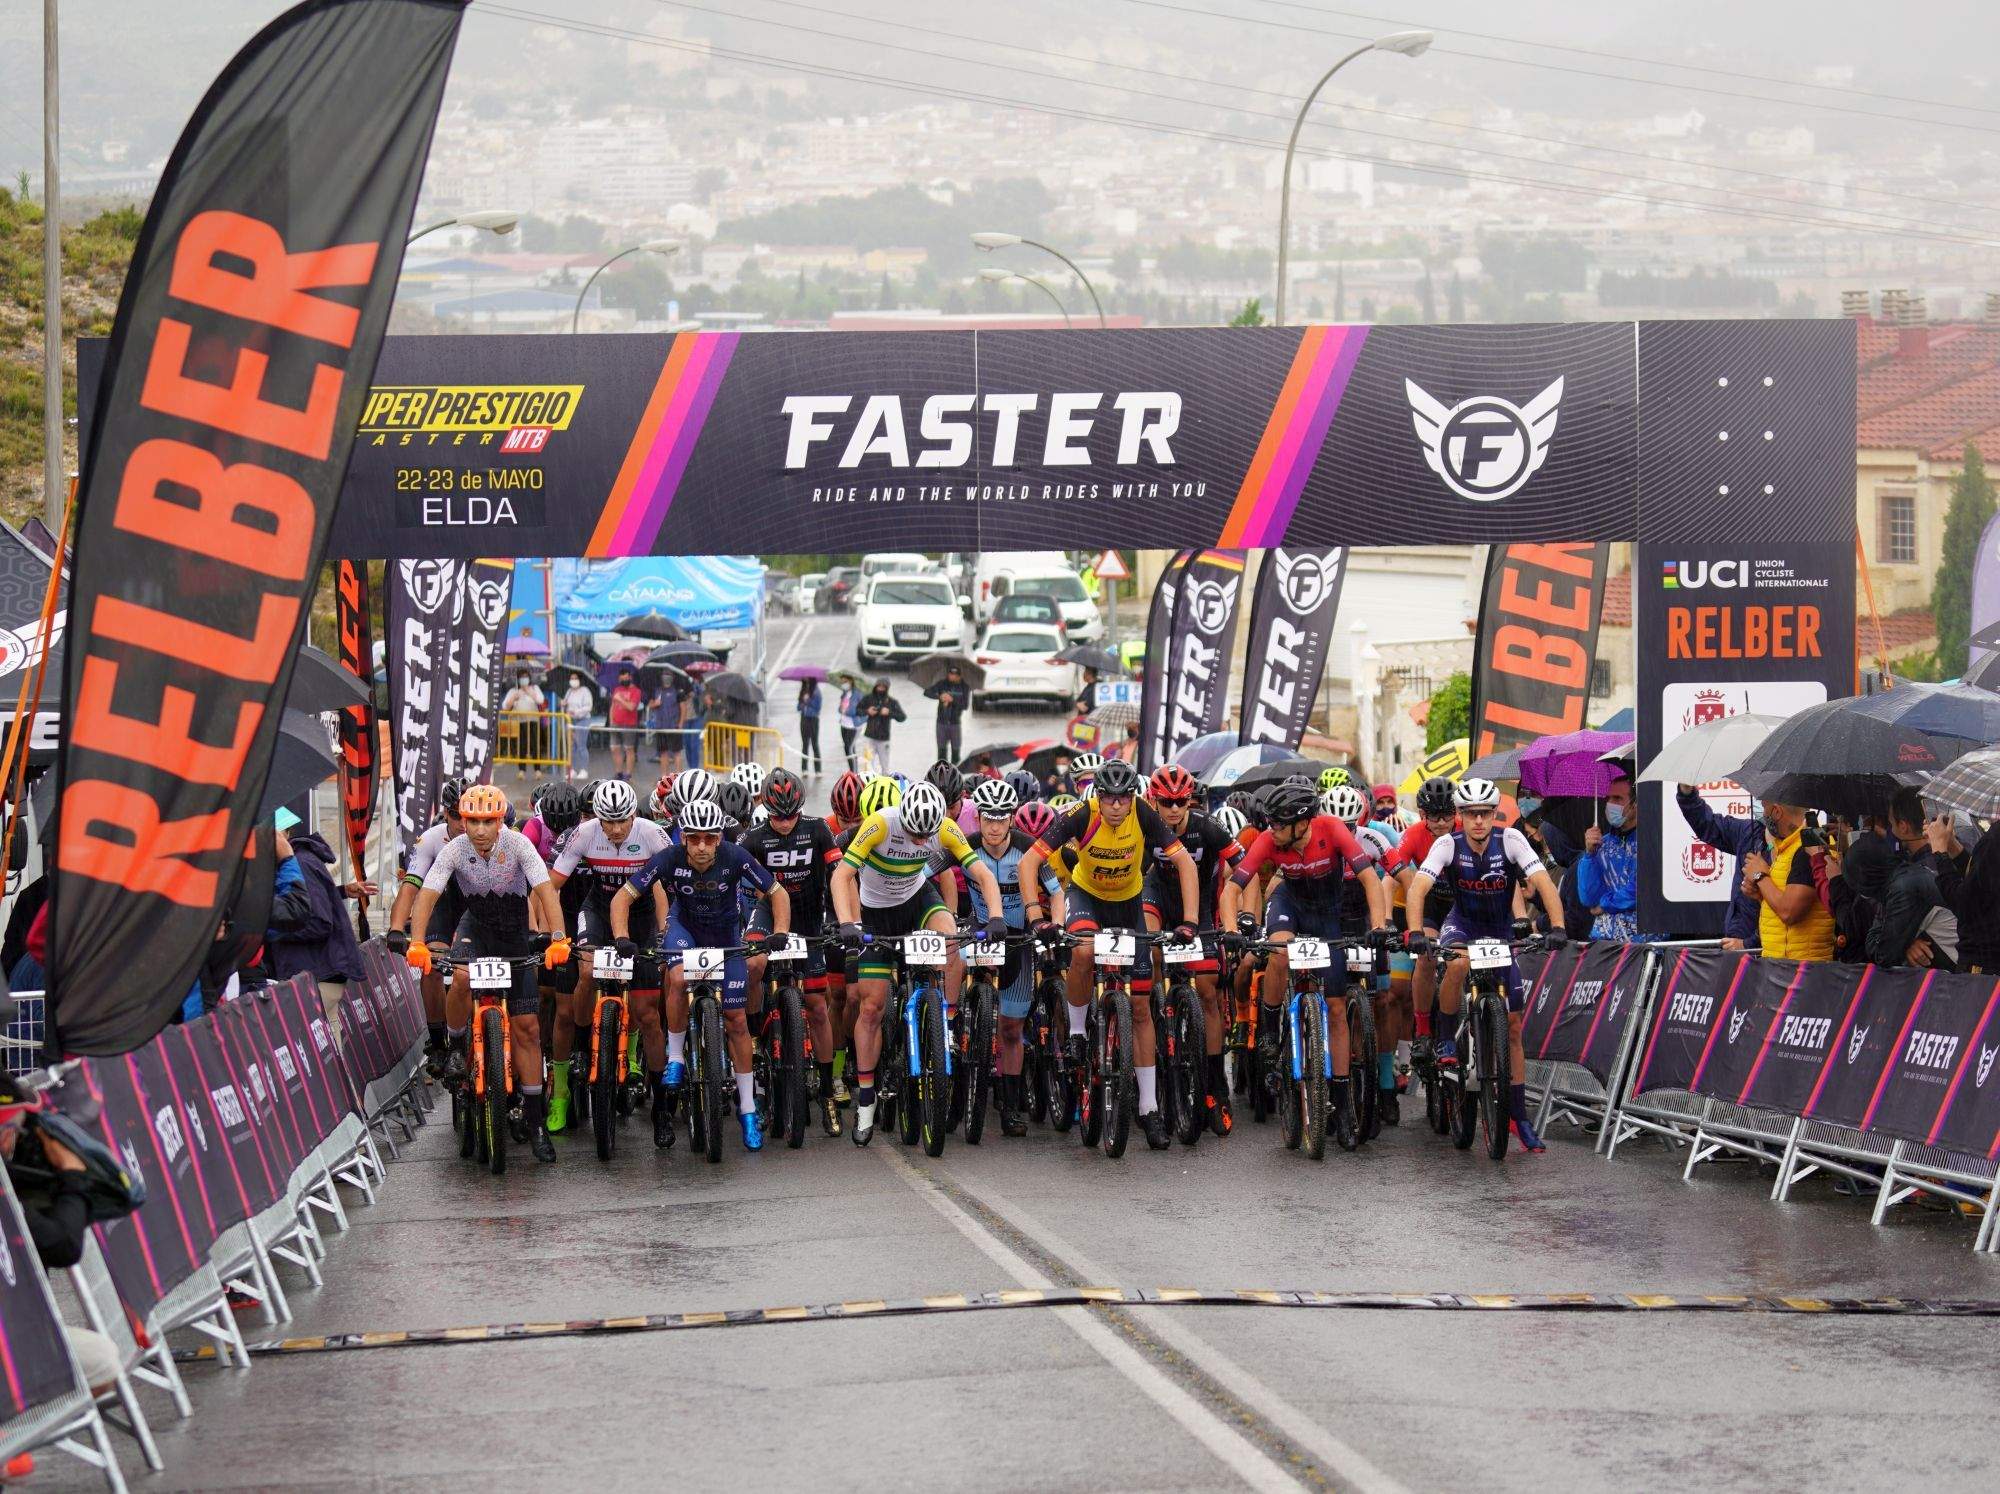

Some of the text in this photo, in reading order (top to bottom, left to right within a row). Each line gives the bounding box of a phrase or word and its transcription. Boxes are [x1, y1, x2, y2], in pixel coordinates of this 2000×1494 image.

[360, 391, 572, 426] PER PRESTIGIO
[357, 433, 494, 446] ASTER
[504, 428, 546, 449] MTB
[781, 391, 1183, 469] FASTER
[461, 469, 482, 490] de
[489, 468, 543, 489] MAYO
[812, 482, 1208, 503] RIDE AND THE WORLD RIDES WITH YOU
[423, 497, 518, 525] ELDA
[58, 210, 379, 908] RELBER
[1755, 560, 1785, 568] UNION
[1679, 560, 1749, 589] UCI
[1754, 579, 1829, 588] INTERNATIONALE
[1755, 569, 1795, 577] CYCLISTE
[1668, 605, 1822, 659] RELBER
[1477, 543, 1595, 760] LBE
[1250, 617, 1306, 743] TER
[463, 631, 490, 783] STER
[1169, 633, 1215, 760] TER
[400, 617, 433, 833] ASTER
[767, 848, 814, 867] BH
[674, 867, 693, 878] BH
[910, 937, 941, 953] 109
[1297, 942, 1319, 958] 42
[1479, 946, 1500, 957] 16
[474, 963, 506, 978] 115
[698, 950, 709, 969] 6
[728, 980, 745, 989] BH
[1668, 992, 1714, 1025] FASTER
[1779, 1015, 1831, 1049] FASTER
[1905, 1030, 1959, 1070] FASTER
